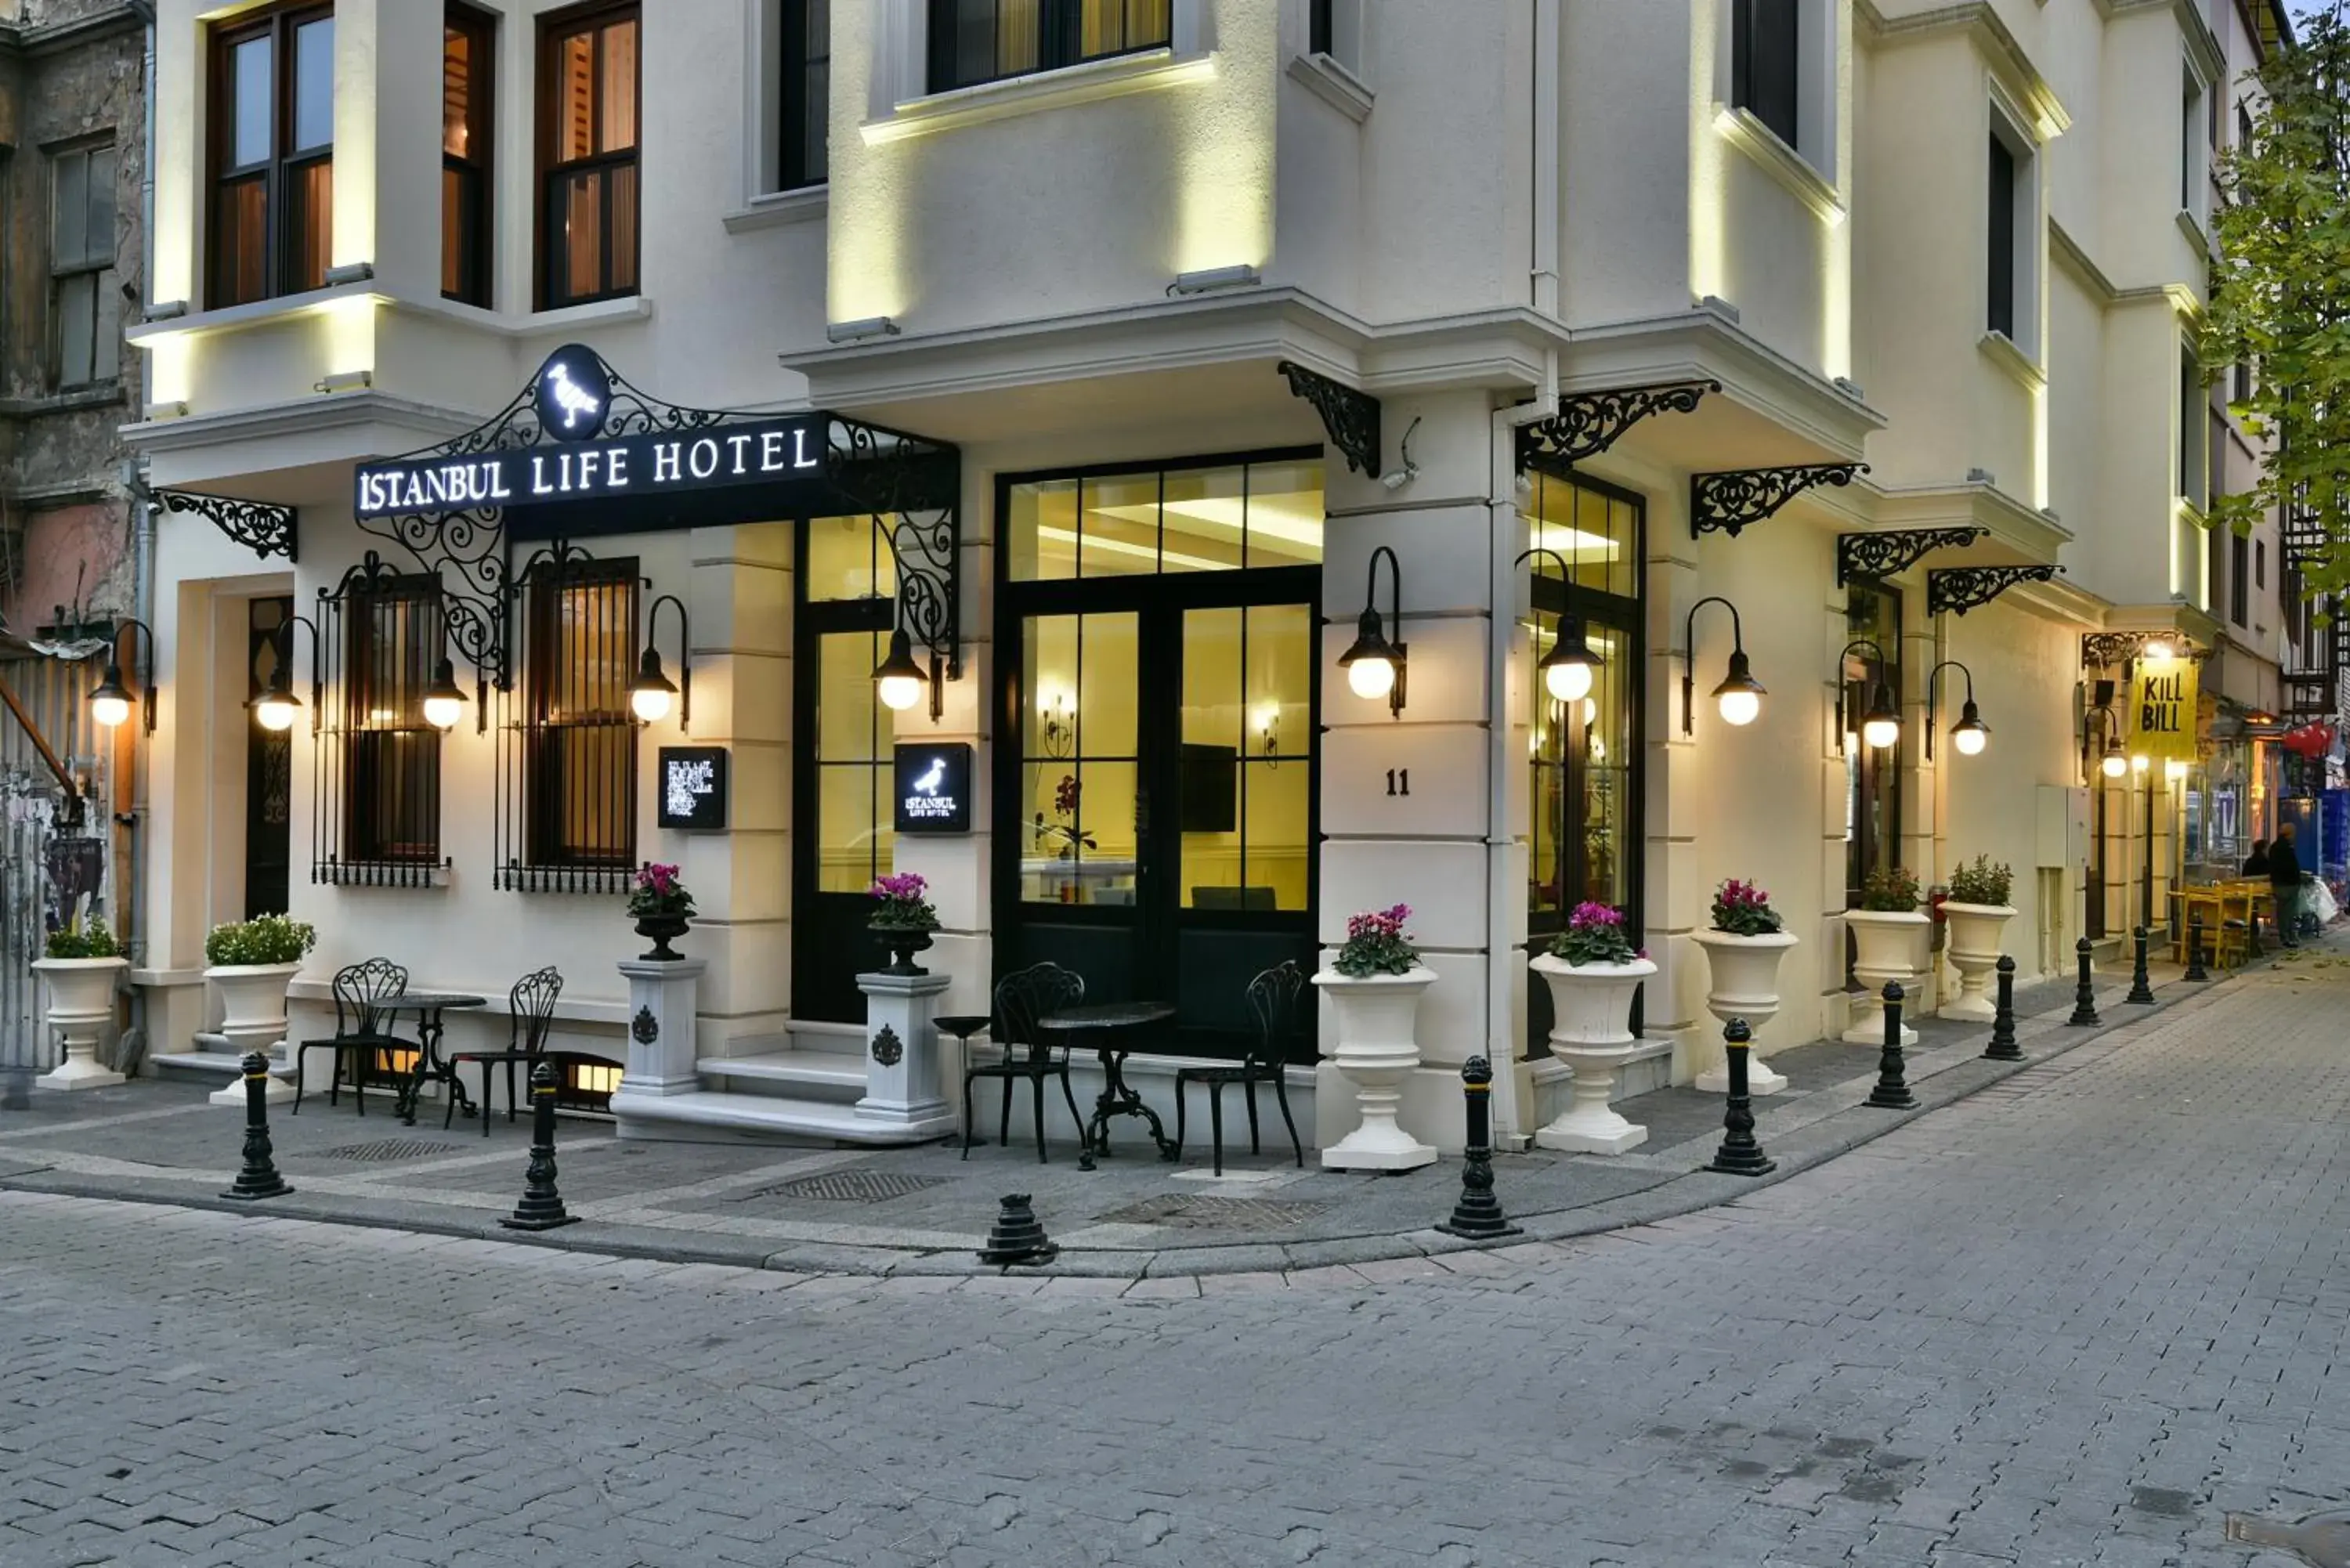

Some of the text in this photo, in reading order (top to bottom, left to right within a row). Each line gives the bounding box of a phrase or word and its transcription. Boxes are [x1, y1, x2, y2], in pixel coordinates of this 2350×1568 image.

[532, 447, 629, 494] LIFE
[653, 429, 817, 482] HOTEL
[2144, 672, 2184, 702] KILL
[2141, 703, 2180, 732] BILL
[1386, 768, 1409, 797] 11
